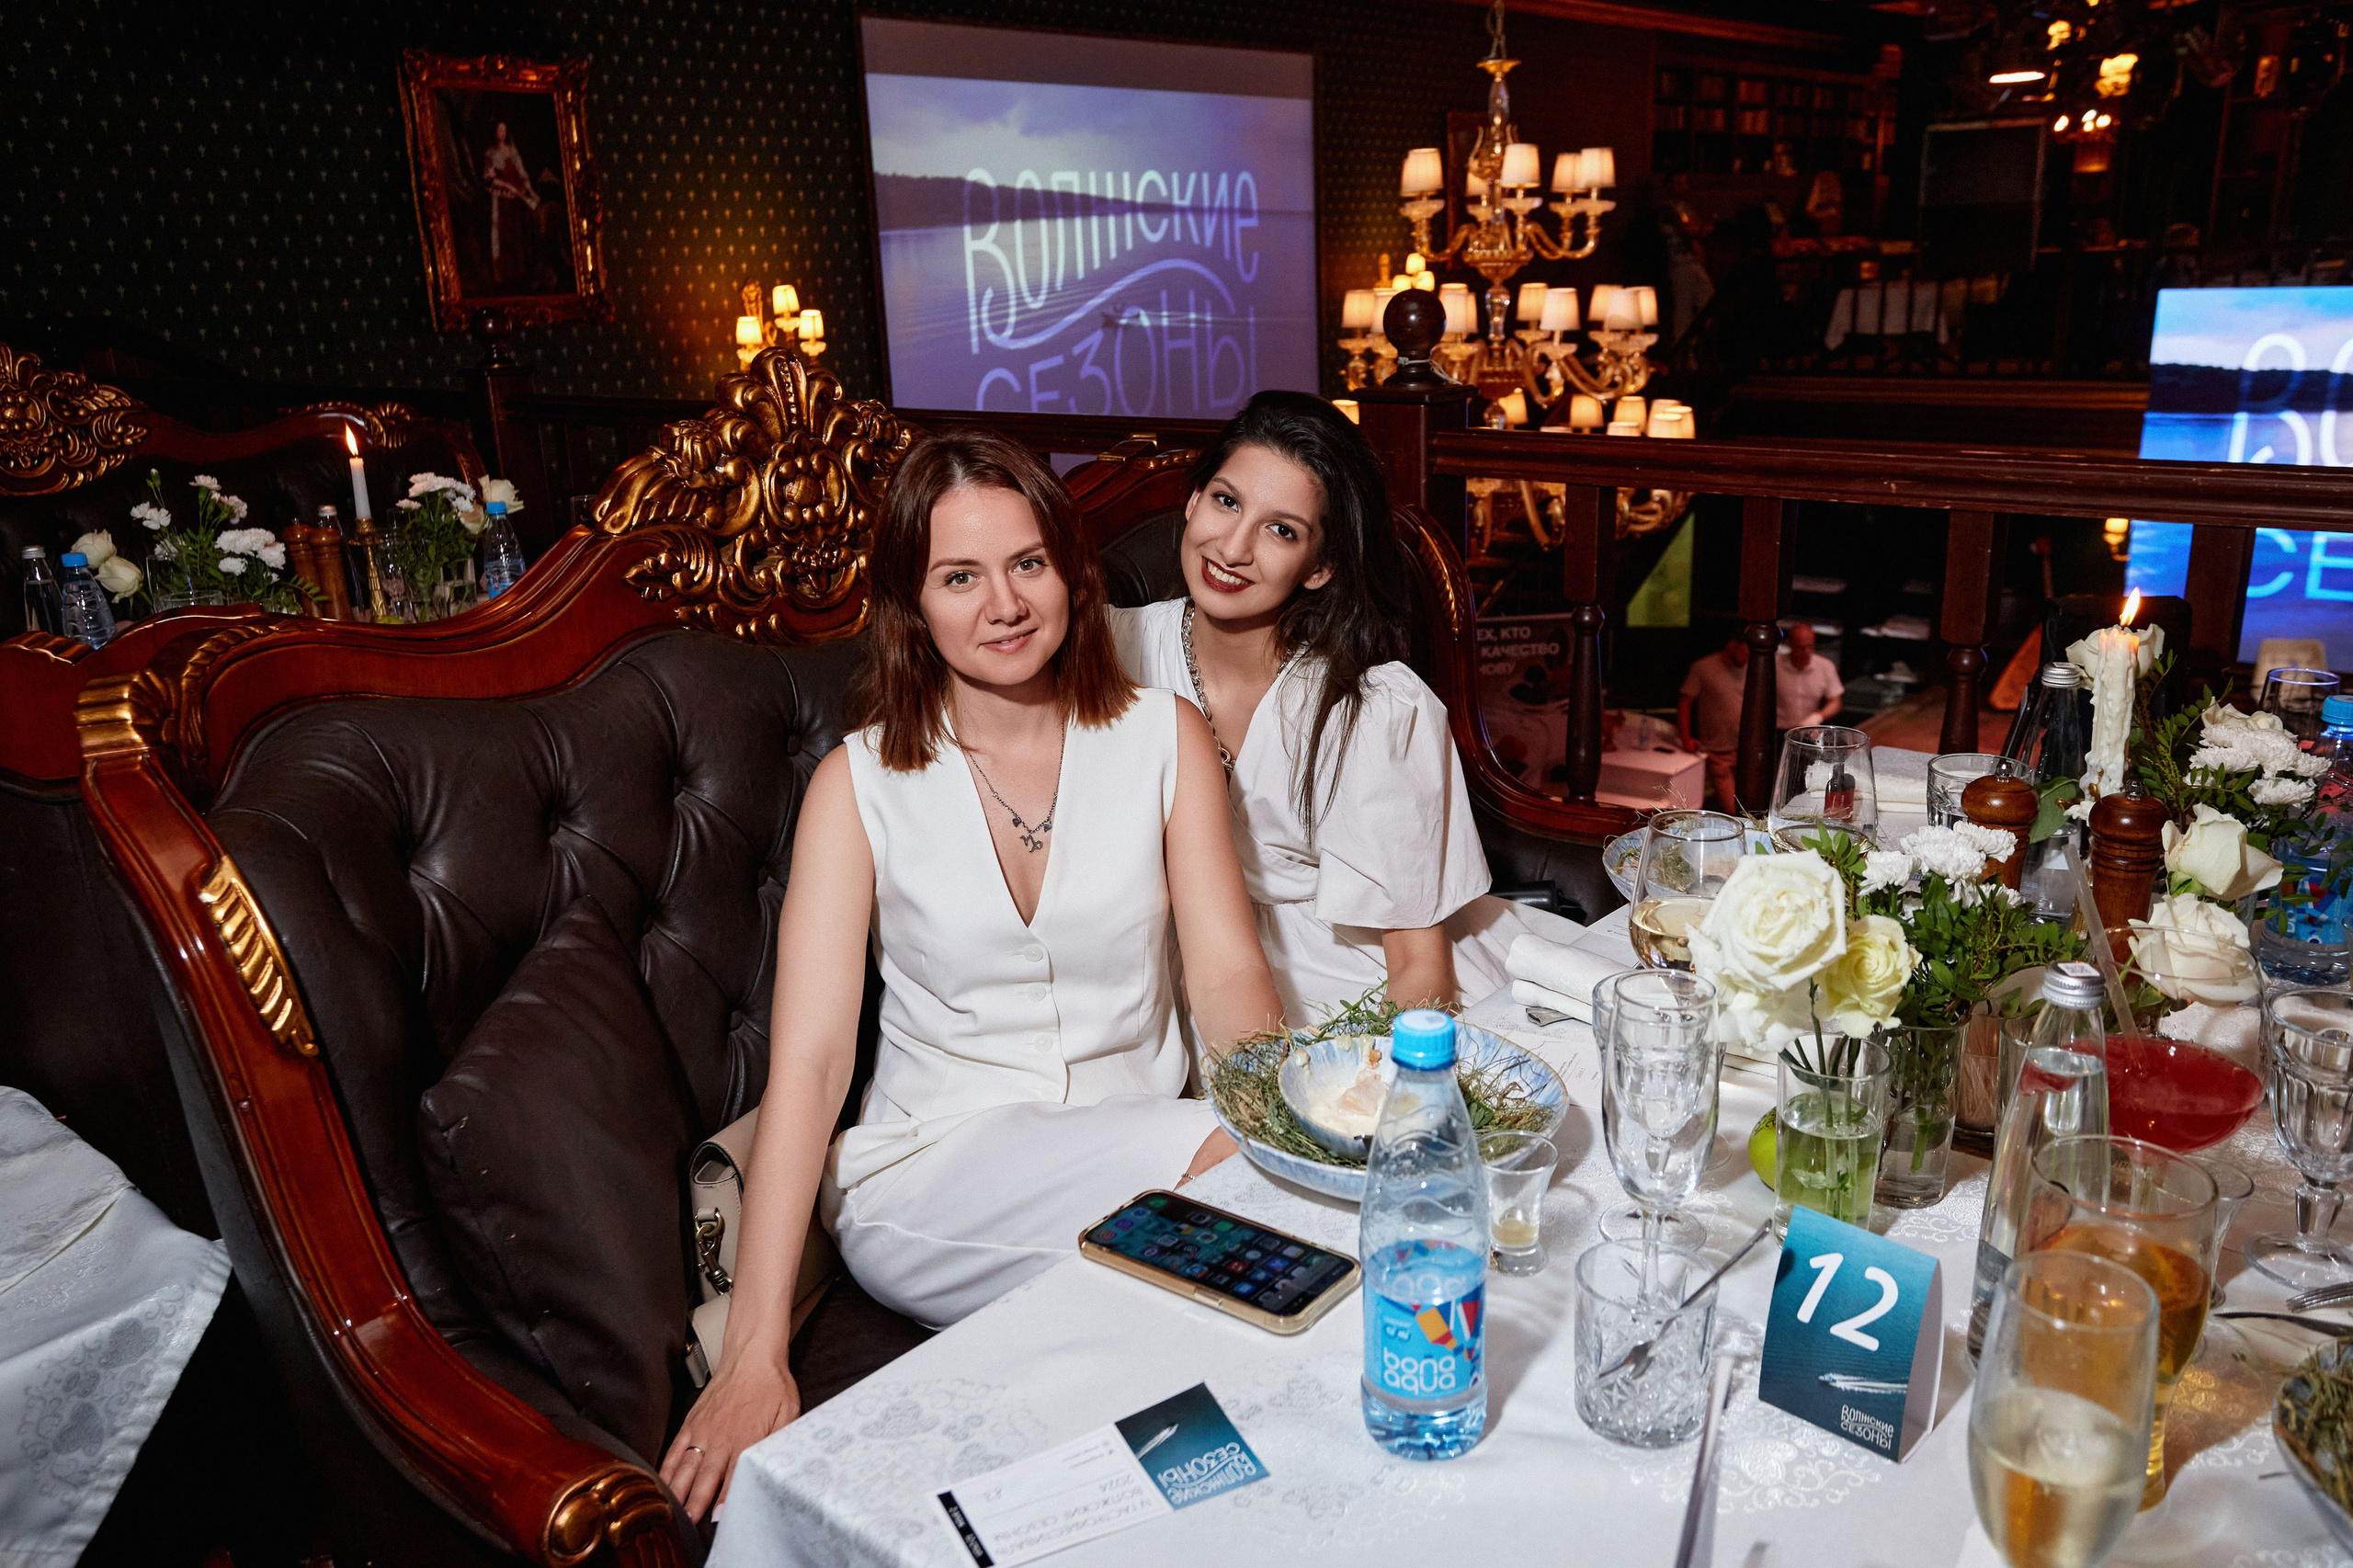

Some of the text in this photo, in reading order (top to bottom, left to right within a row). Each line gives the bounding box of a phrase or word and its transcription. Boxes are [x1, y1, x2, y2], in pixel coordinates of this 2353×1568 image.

[1500, 626, 1531, 640] КТО
[1481, 642, 1560, 658] КАЧЕСТВО
[1796, 1252, 1900, 1352] 12
